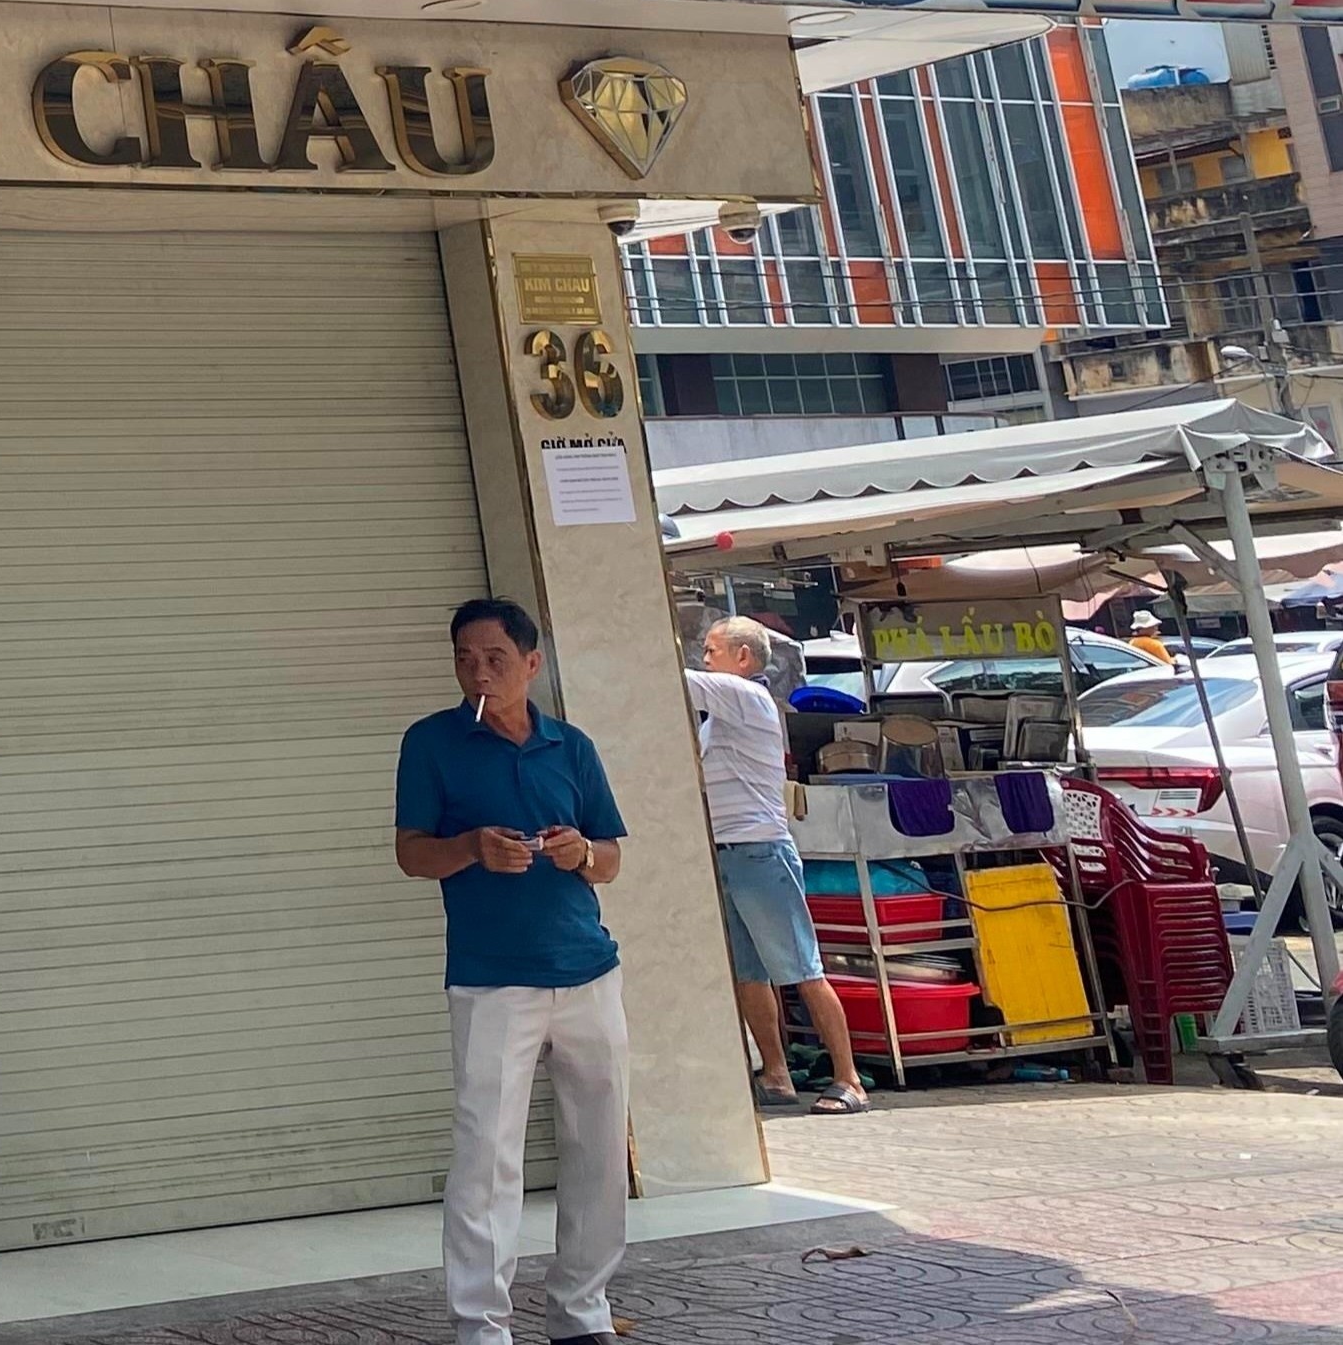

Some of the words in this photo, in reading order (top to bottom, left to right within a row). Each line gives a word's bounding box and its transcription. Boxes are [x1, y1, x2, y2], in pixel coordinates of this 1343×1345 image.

[33, 26, 495, 177] CHÂU
[524, 330, 624, 420] 36
[1014, 610, 1056, 653] BÒ
